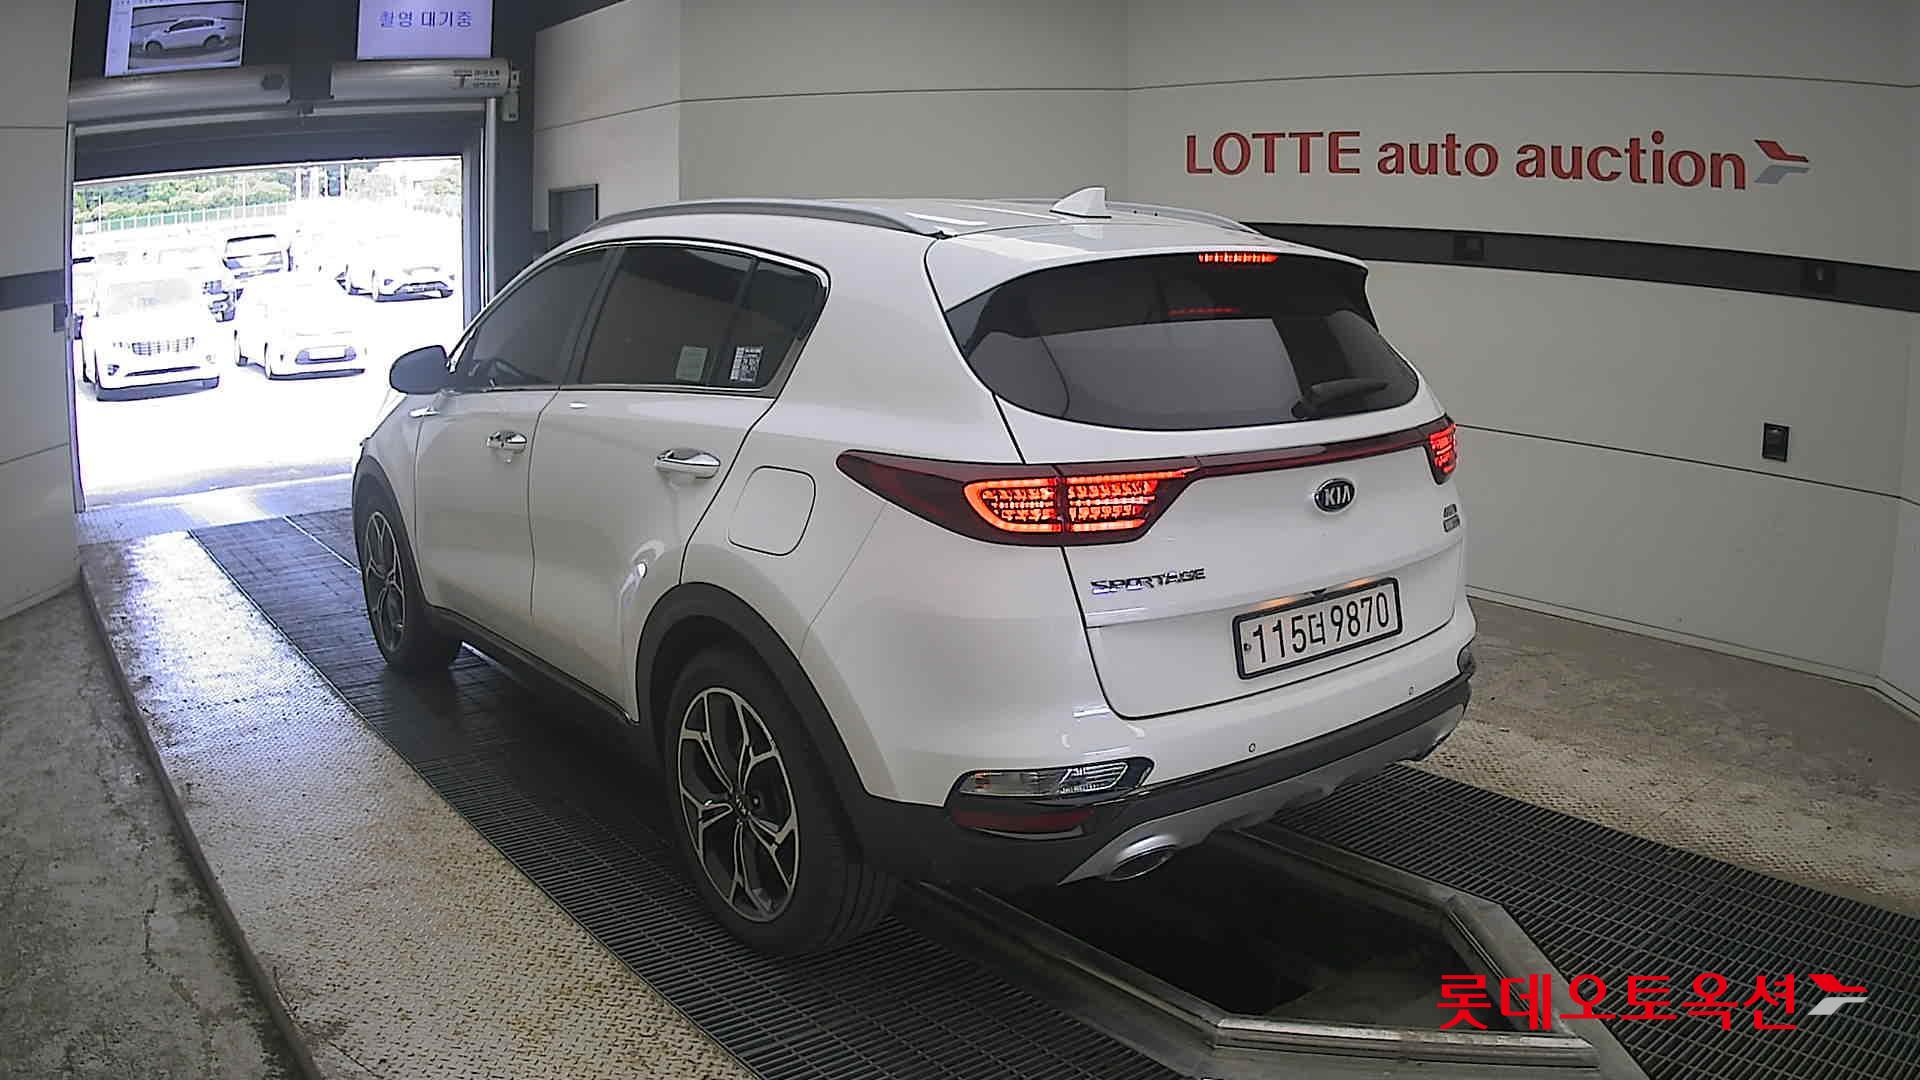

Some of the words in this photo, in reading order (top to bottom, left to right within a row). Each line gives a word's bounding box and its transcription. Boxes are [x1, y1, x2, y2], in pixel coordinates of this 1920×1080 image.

[421, 11, 472, 28] 대기중
[1186, 131, 1361, 175] LOTTE
[1377, 134, 1499, 177] auto
[1515, 131, 1747, 190] auction
[1324, 485, 1351, 506] KIA
[1090, 568, 1206, 595] SPORTAGE
